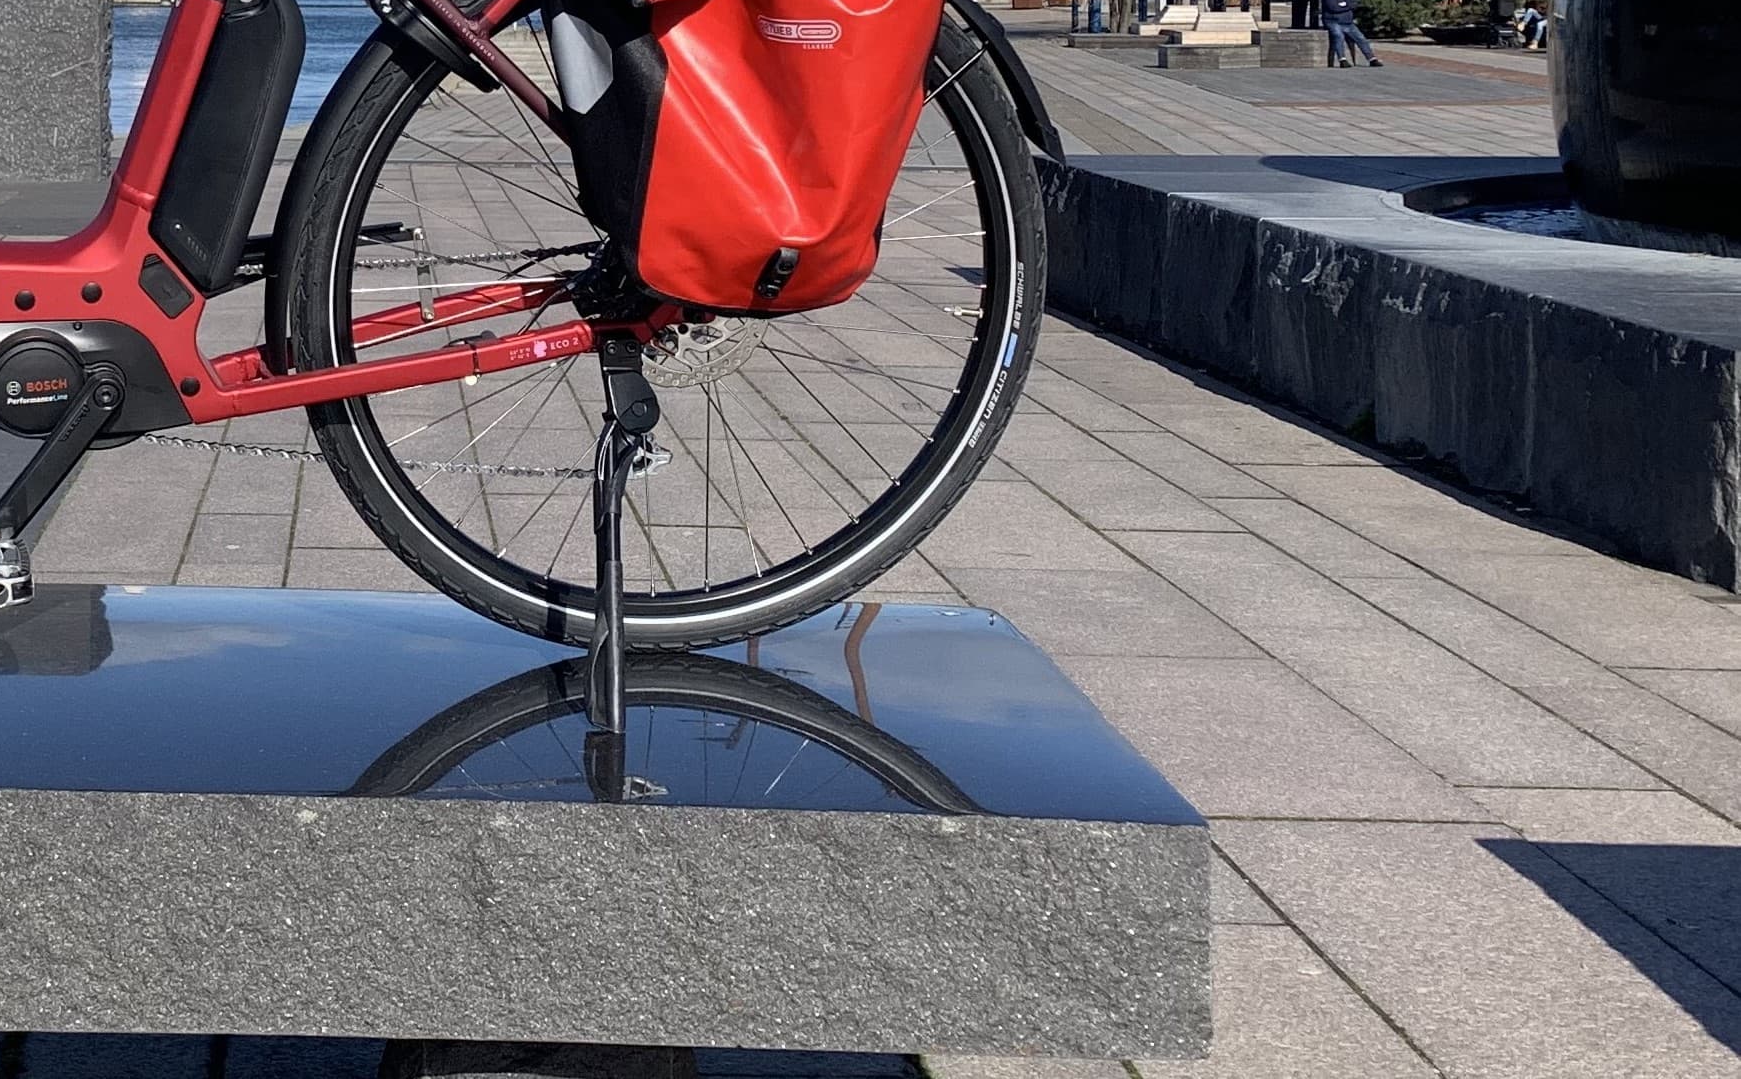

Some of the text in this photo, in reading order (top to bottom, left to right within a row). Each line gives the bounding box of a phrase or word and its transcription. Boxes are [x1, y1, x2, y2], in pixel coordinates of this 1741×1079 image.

[1012, 260, 1025, 330] SCHWALBE
[549, 336, 579, 351] ECO 2
[25, 378, 68, 393] BOSCH
[983, 369, 1009, 421] CITIZEN
